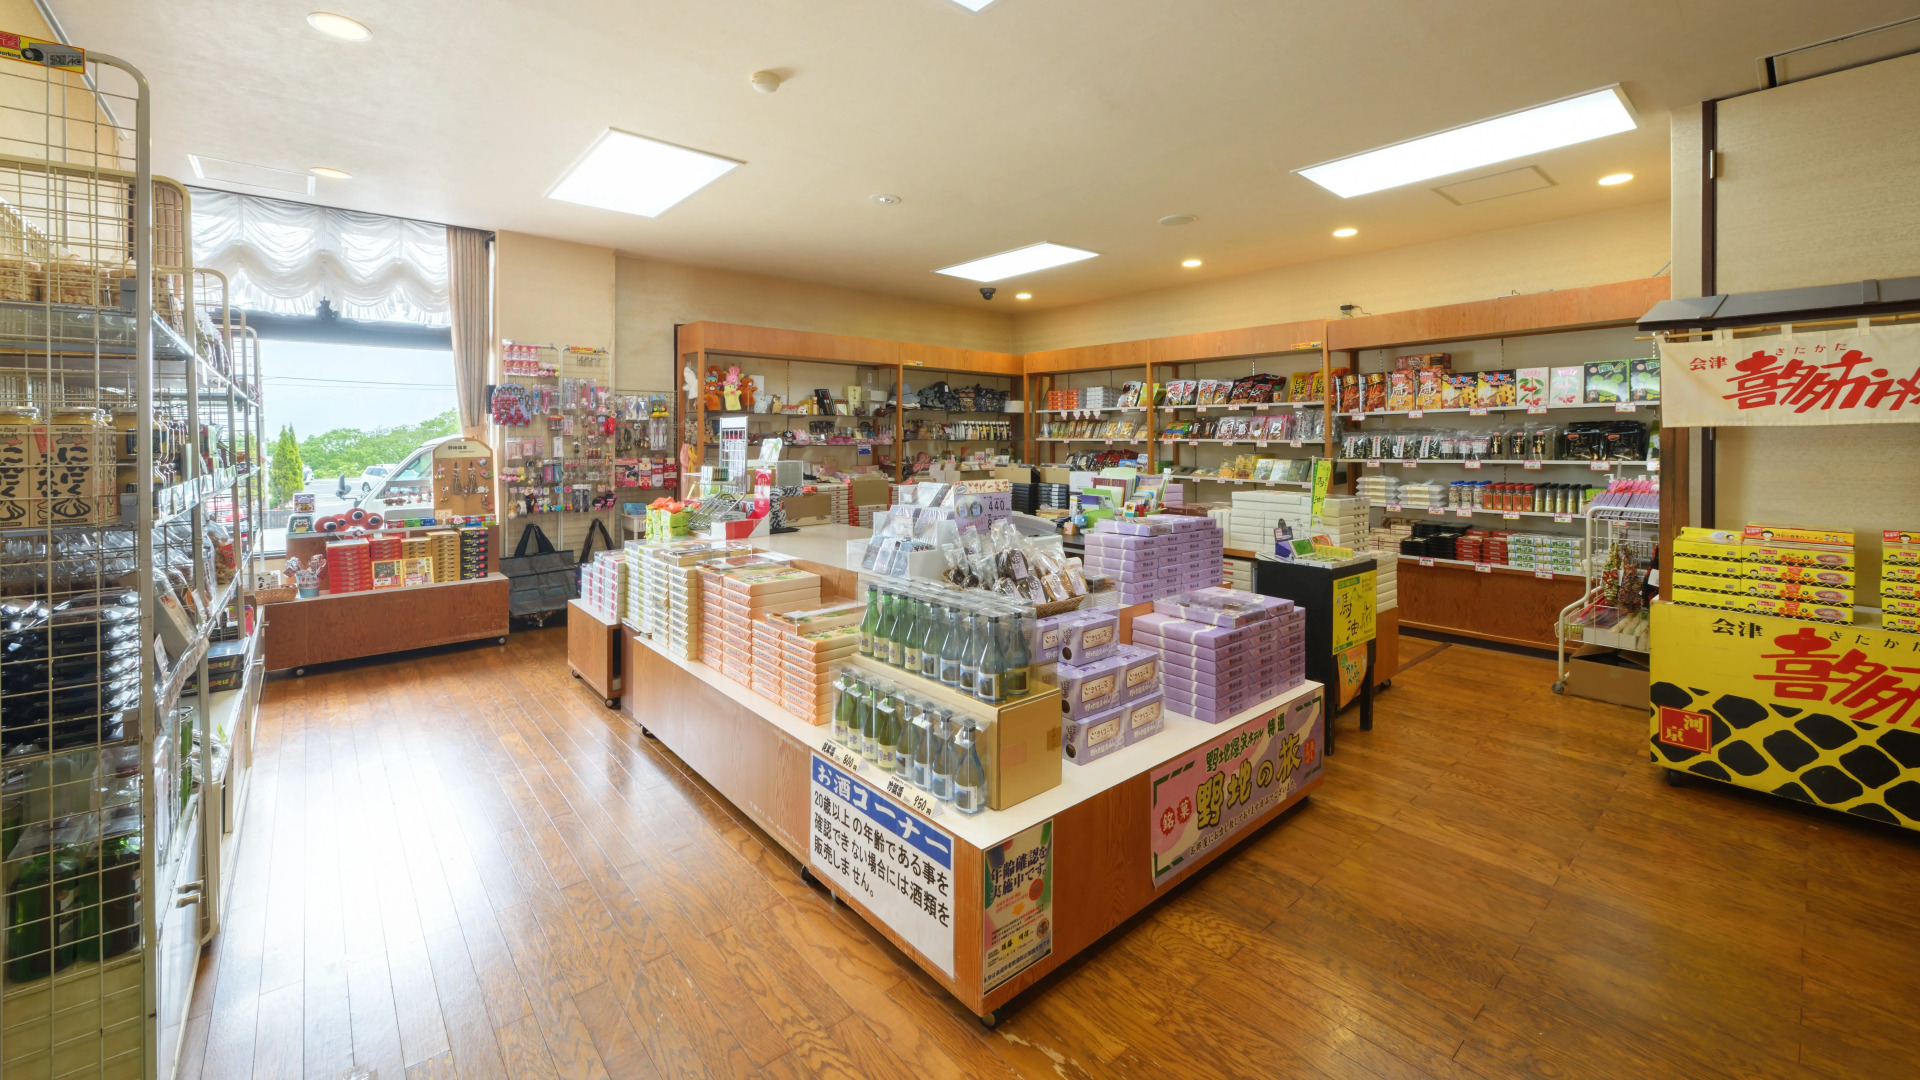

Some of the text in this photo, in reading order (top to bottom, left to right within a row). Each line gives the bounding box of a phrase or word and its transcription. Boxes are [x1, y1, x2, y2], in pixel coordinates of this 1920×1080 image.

[1689, 355, 1728, 371] 会津
[1775, 342, 1848, 357] きたかた
[1712, 617, 1764, 639] 会津
[1206, 729, 1264, 773] 野地温泉ホテル
[1267, 713, 1286, 737] 特選
[817, 764, 949, 854] お酒コーナー
[1195, 732, 1302, 831] 野地の旅
[814, 790, 949, 897] 20歳以上の年齢である事を
[814, 837, 875, 898] 販売しません。
[814, 812, 950, 928] 確認できない場合には酒類を
[991, 845, 1048, 883] 年齢確認を
[990, 862, 1047, 902] 実施中です。
